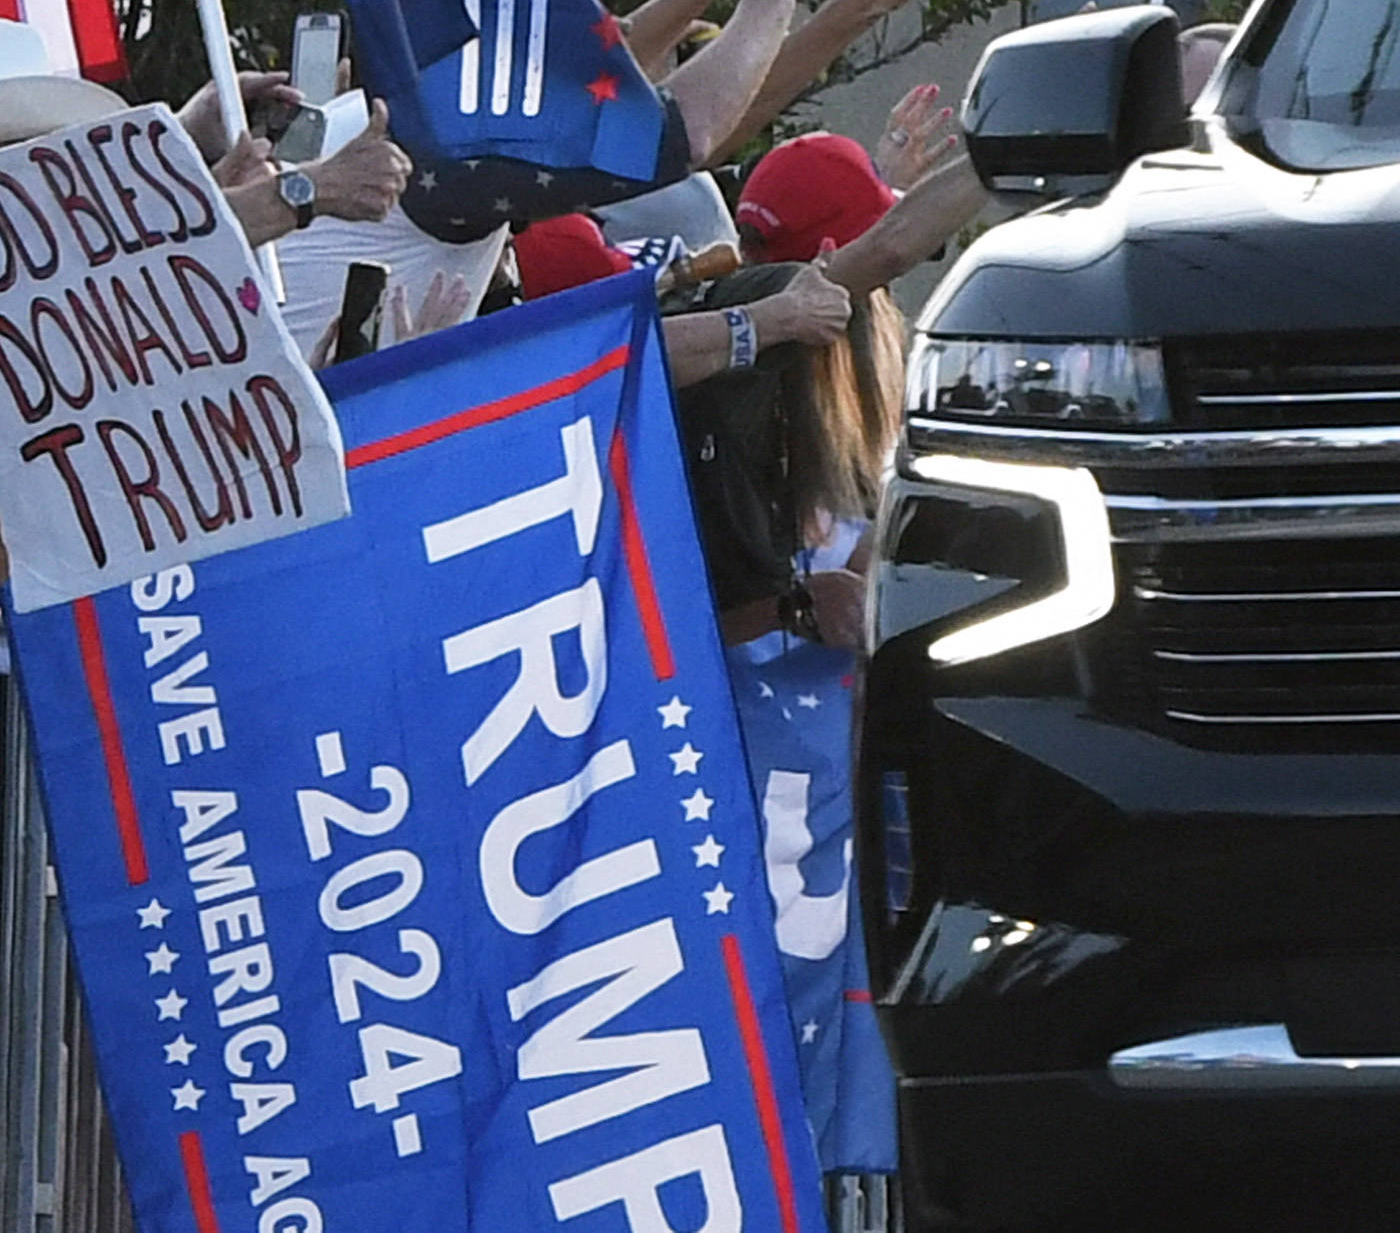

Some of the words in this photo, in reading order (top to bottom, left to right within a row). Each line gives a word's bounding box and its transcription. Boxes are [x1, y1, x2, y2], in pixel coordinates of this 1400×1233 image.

[29, 118, 217, 268] BLESS
[20, 373, 304, 569] TRUMP
[130, 563, 228, 766] SAVE
[423, 415, 742, 1233] TRUMP
[170, 789, 297, 1136] AMERICA
